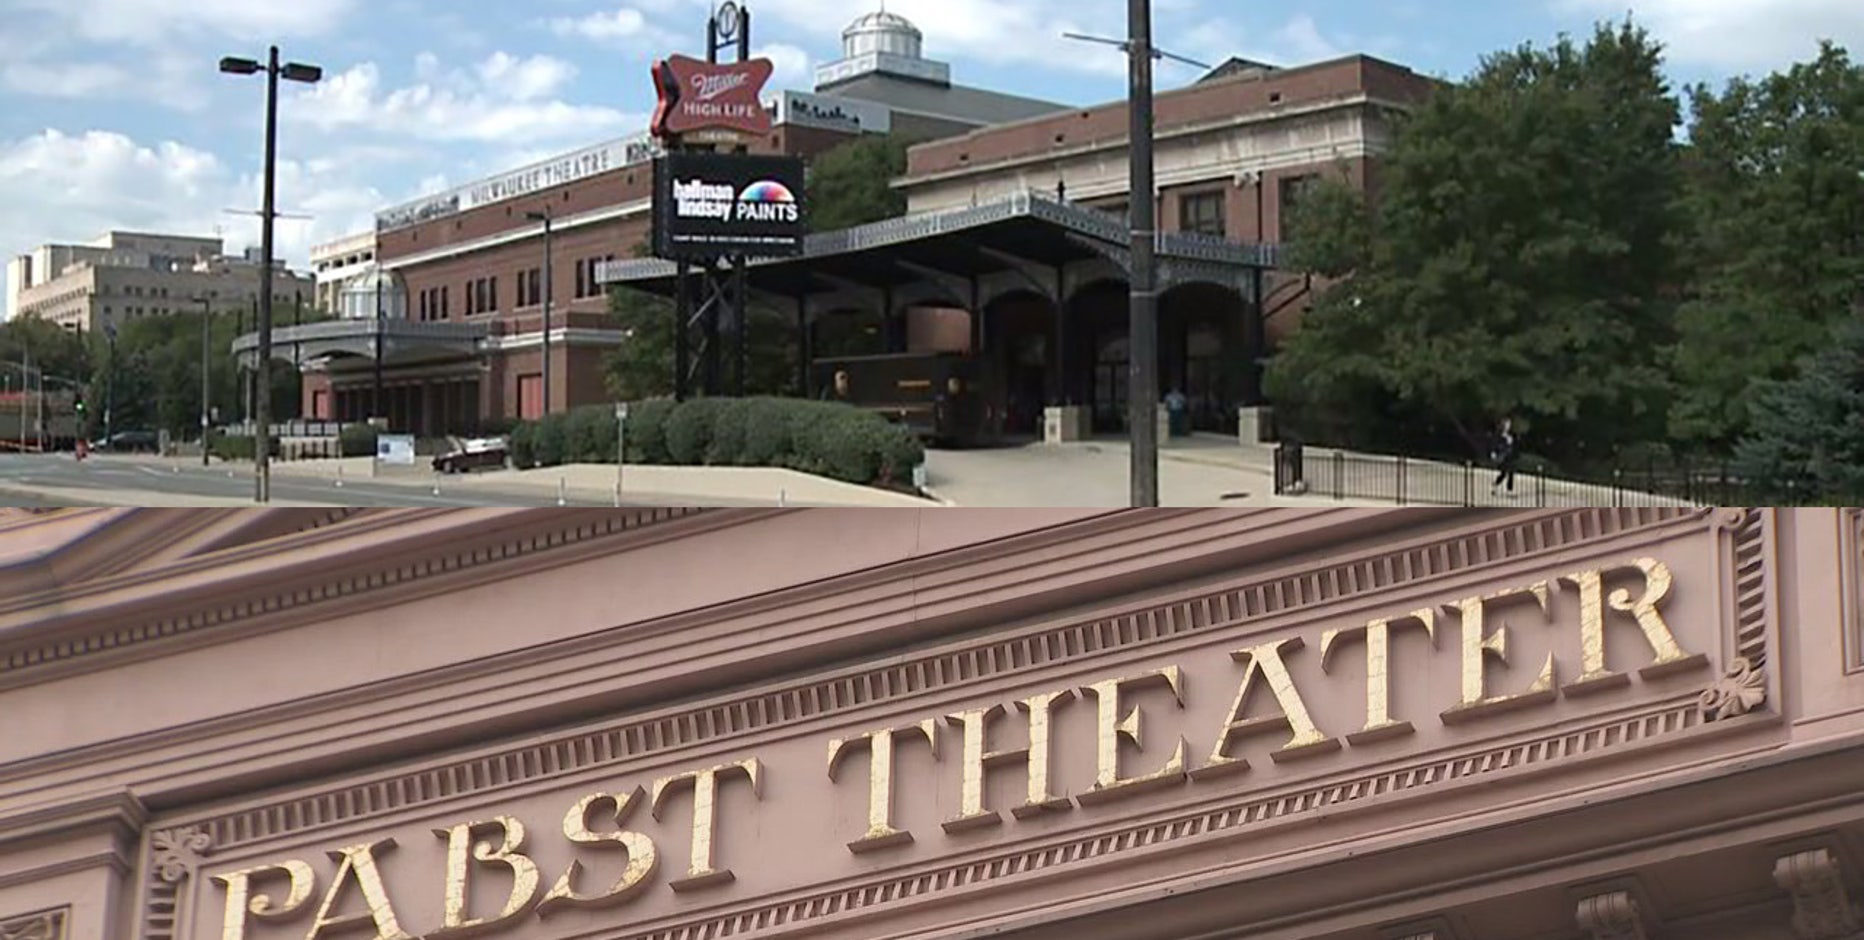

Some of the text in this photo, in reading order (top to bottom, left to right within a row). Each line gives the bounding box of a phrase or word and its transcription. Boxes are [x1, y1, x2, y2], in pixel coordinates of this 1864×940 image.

[691, 73, 749, 100] Miller
[684, 102, 755, 118] HIGH LIFE
[471, 150, 609, 203] MILWAUKEE THEATRE
[673, 179, 734, 200] hallman
[678, 199, 798, 222] lindsay PAINTS
[209, 556, 1710, 940] PABST THEATER
